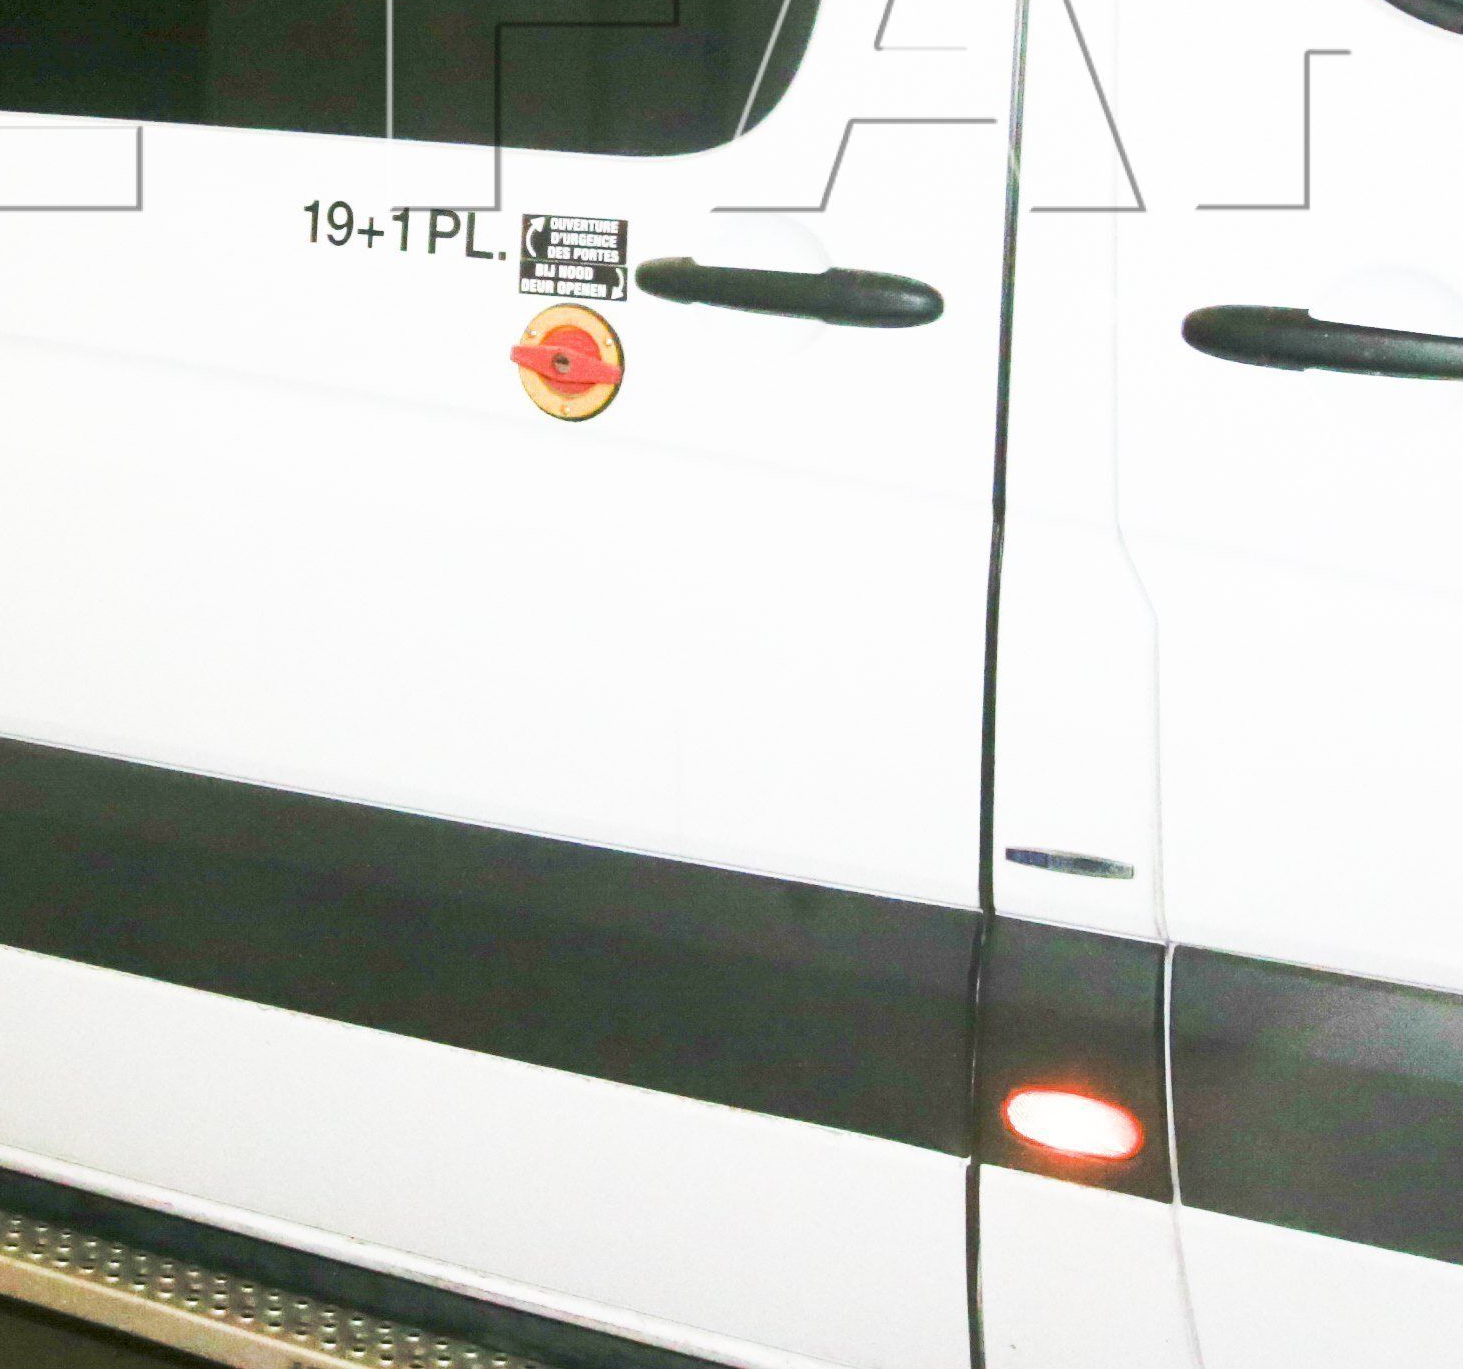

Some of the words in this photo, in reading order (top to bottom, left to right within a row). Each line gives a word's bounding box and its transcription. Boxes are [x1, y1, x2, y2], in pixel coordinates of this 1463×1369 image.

[549, 216, 620, 234] OUVERTURE
[549, 231, 618, 249] D'URGENCE
[546, 244, 571, 260] DES
[573, 247, 620, 263] PORTES
[558, 264, 594, 281] NOOD
[520, 277, 555, 294] DEUR
[556, 279, 607, 298] OPENEN
